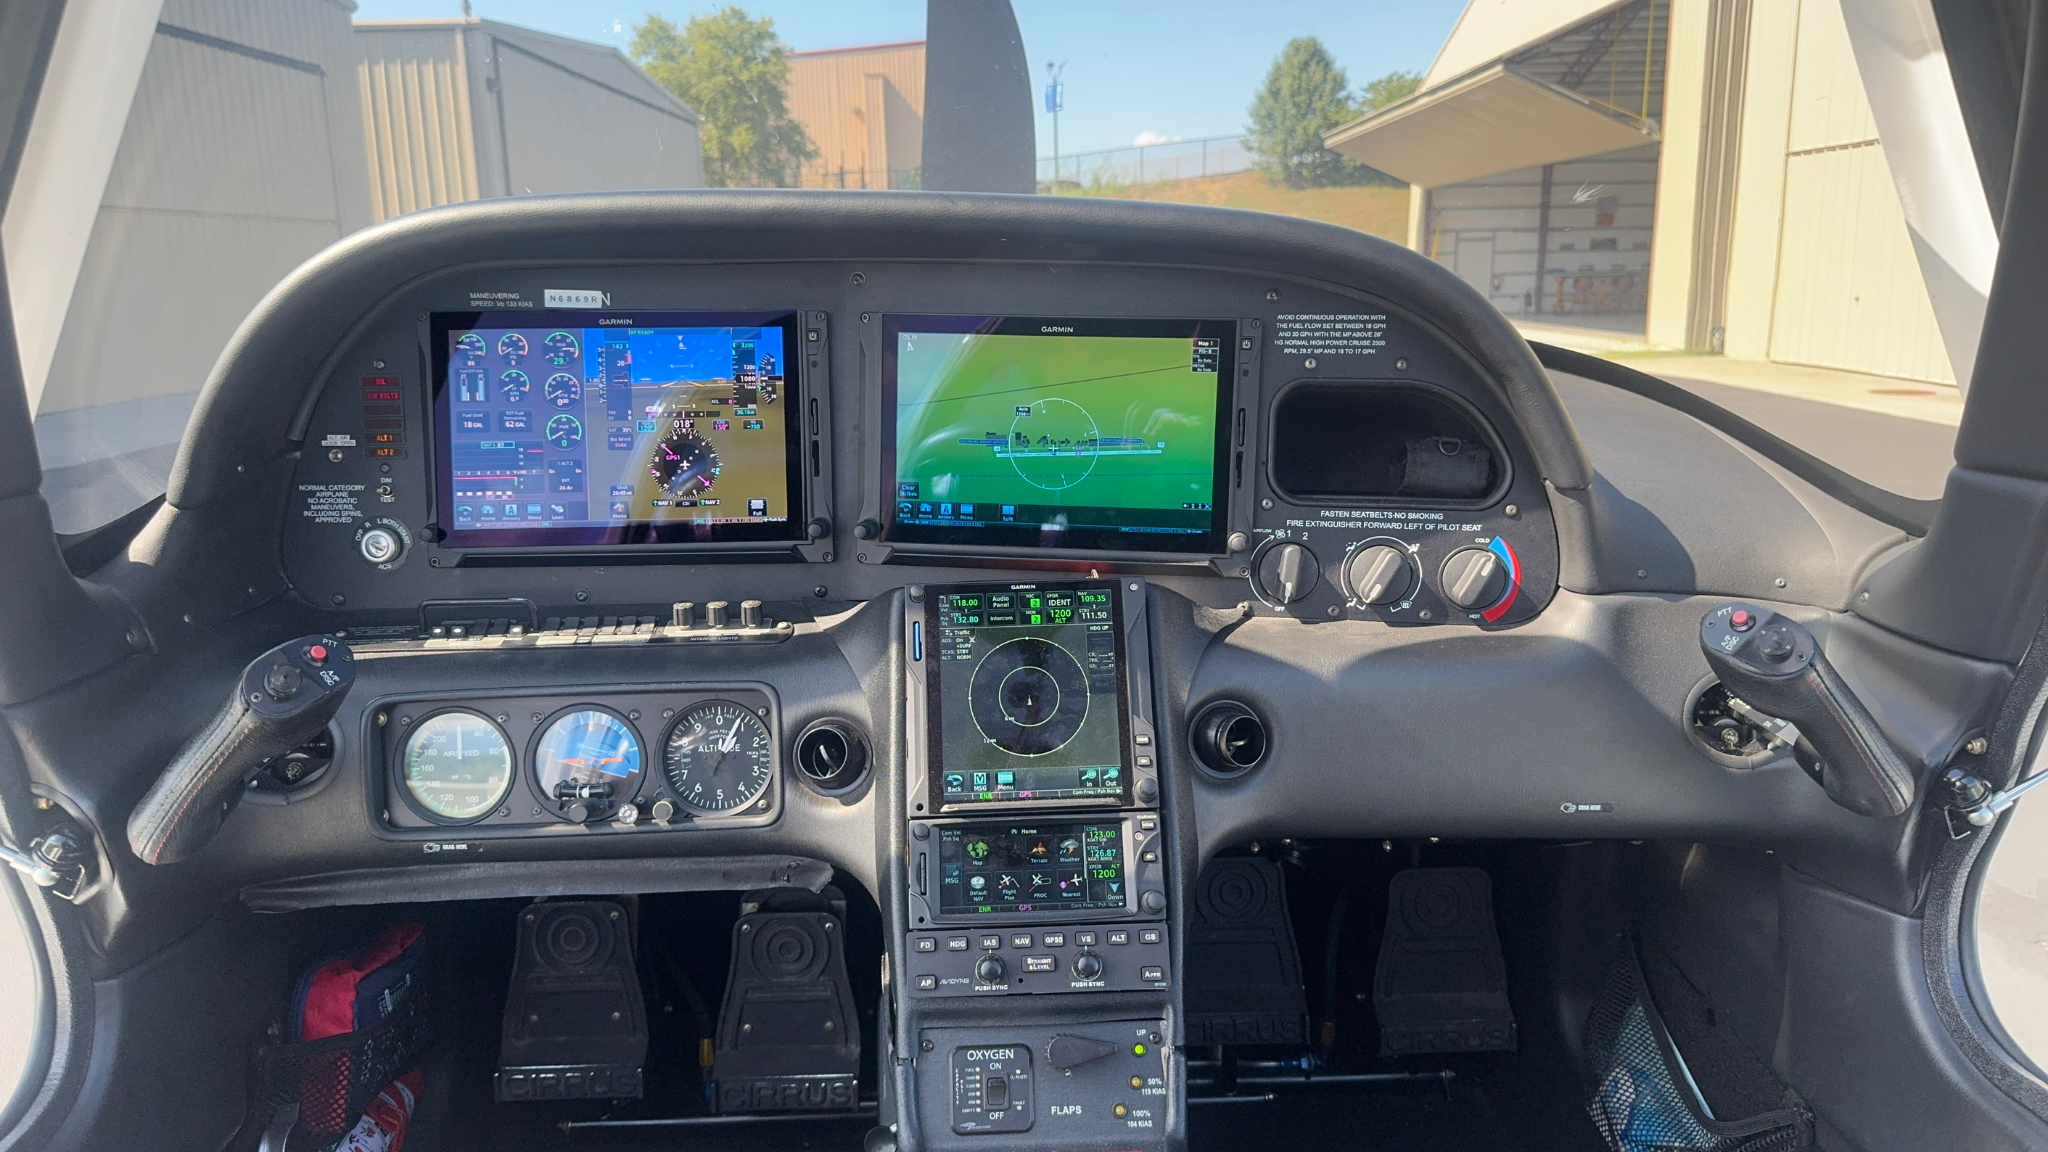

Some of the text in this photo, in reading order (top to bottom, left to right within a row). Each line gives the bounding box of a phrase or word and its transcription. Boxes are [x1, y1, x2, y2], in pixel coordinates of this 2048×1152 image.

[674, 419, 693, 428] 018°
[1320, 510, 1349, 518] FASTEN
[1407, 512, 1443, 520] SMOKING
[1306, 520, 1362, 528] EXTINGUISHER
[1363, 521, 1402, 529] FORWARD
[1404, 522, 1424, 530] LEFT
[1438, 523, 1460, 531] PILOT
[1462, 524, 1482, 532] SEAT
[355, 518, 410, 544] OFF BOTH START
[1302, 532, 1308, 540] 2
[1050, 610, 1071, 618] 1200
[1717, 606, 1732, 617] PTT
[322, 638, 338, 648] PTT
[717, 789, 724, 799] 5
[1089, 830, 1116, 839] 123.00
[1090, 849, 1116, 858] 126.87
[1092, 869, 1116, 878] 1200
[1015, 937, 1030, 945] NAV
[1045, 936, 1063, 944] GPSS
[1111, 934, 1125, 942] ALT
[950, 940, 966, 948] HDG
[921, 979, 932, 987] AP
[967, 1049, 1014, 1060] OXYGEN
[989, 1062, 1002, 1070] ON
[508, 1072, 637, 1098] CIRRUS
[724, 1080, 853, 1108] CIRRUS
[1051, 1105, 1082, 1115] FLAPS
[989, 1112, 1004, 1120] OFF
